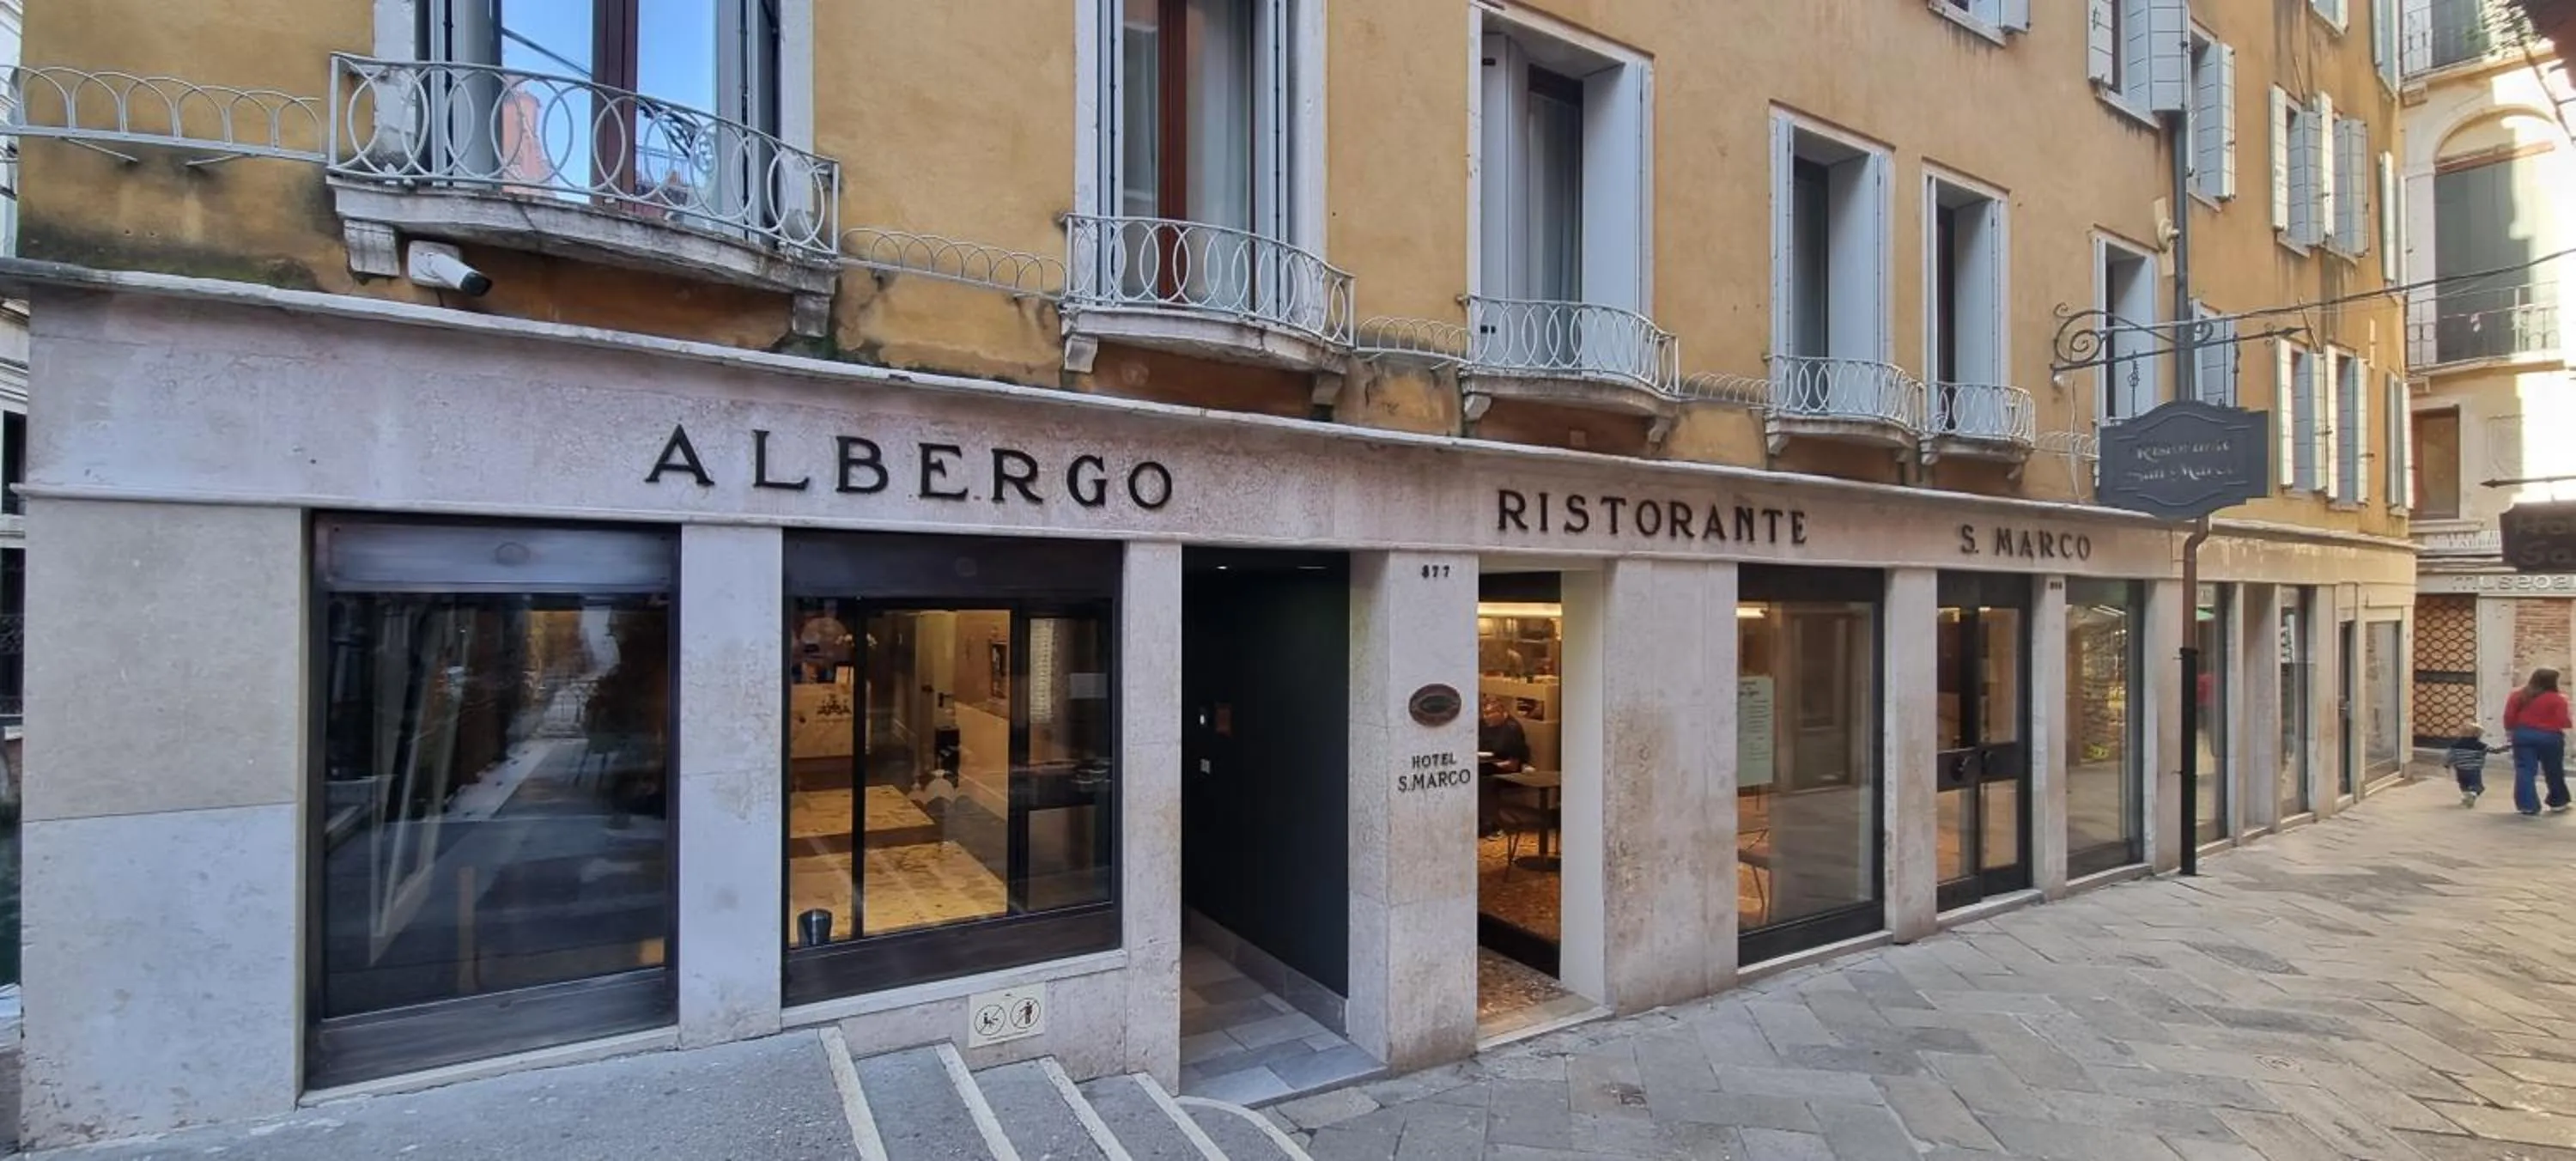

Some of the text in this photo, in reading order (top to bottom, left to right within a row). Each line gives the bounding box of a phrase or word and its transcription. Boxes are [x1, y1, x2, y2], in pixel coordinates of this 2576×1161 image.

[644, 423, 1174, 510] ALBERGO
[1497, 489, 2093, 562] RISTORANTE S. MARCO
[1421, 565, 1450, 579] 877
[1412, 752, 1457, 769] HOTEL
[1398, 769, 1471, 793] S.MARCO
